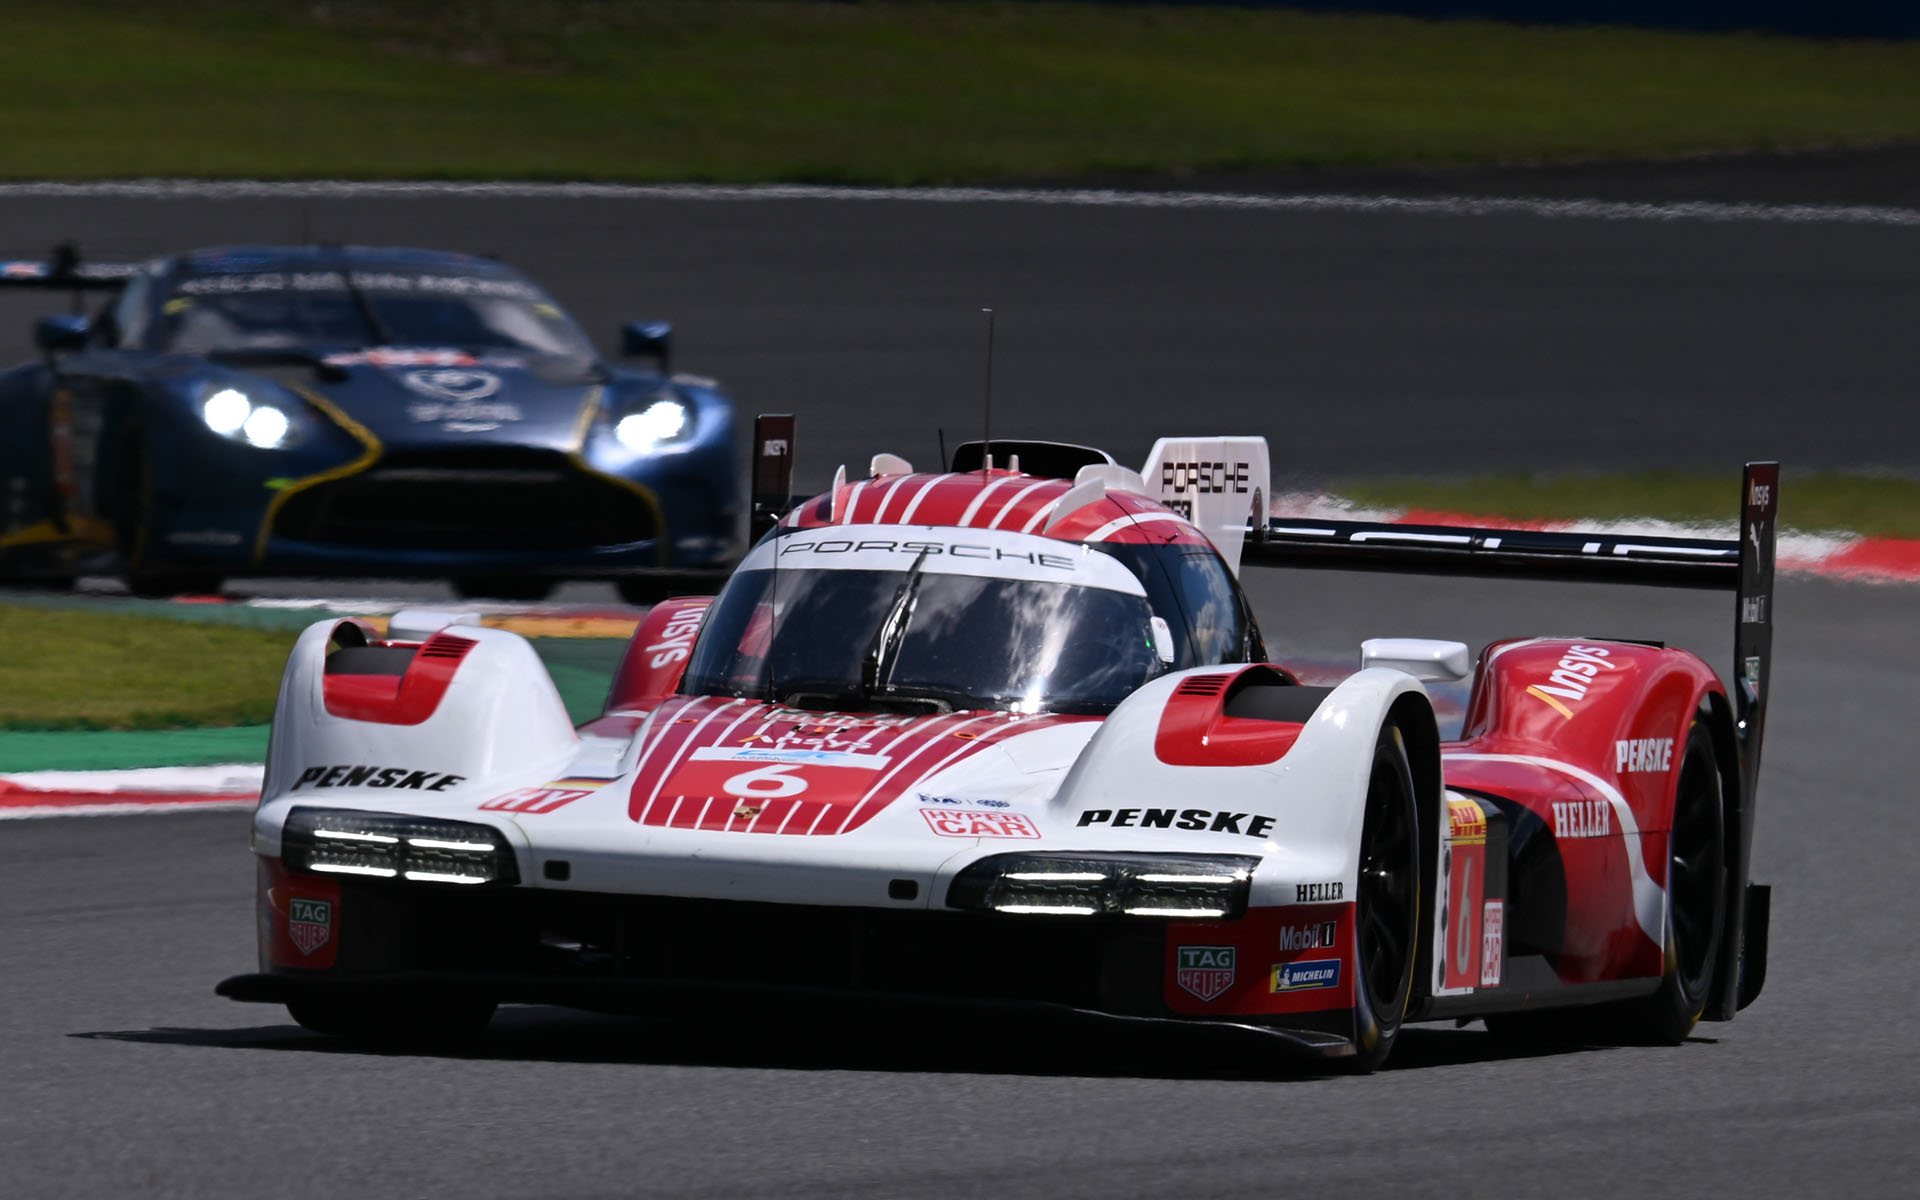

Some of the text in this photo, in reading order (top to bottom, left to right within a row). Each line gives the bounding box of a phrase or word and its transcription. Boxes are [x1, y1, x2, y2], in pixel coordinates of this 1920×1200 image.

[1162, 462, 1249, 493] PORSCHE
[780, 541, 1076, 571] PORSCHE
[1526, 645, 1615, 720] Ansys
[1616, 738, 1674, 773] PENSKE
[290, 766, 467, 792] PENSKE
[723, 764, 808, 798] 6
[927, 810, 1023, 822] HYPER
[936, 820, 1031, 836] CAR
[1076, 808, 1277, 839] PENSKE
[1552, 801, 1611, 838] HELLER
[1296, 882, 1344, 902] HELLER
[293, 904, 326, 922] TAG
[1457, 856, 1473, 976] 6
[1279, 923, 1320, 951] Mobil
[1183, 951, 1230, 966] TAG
[1179, 971, 1232, 1000] HEUER
[1292, 968, 1335, 982] MICHELIN
